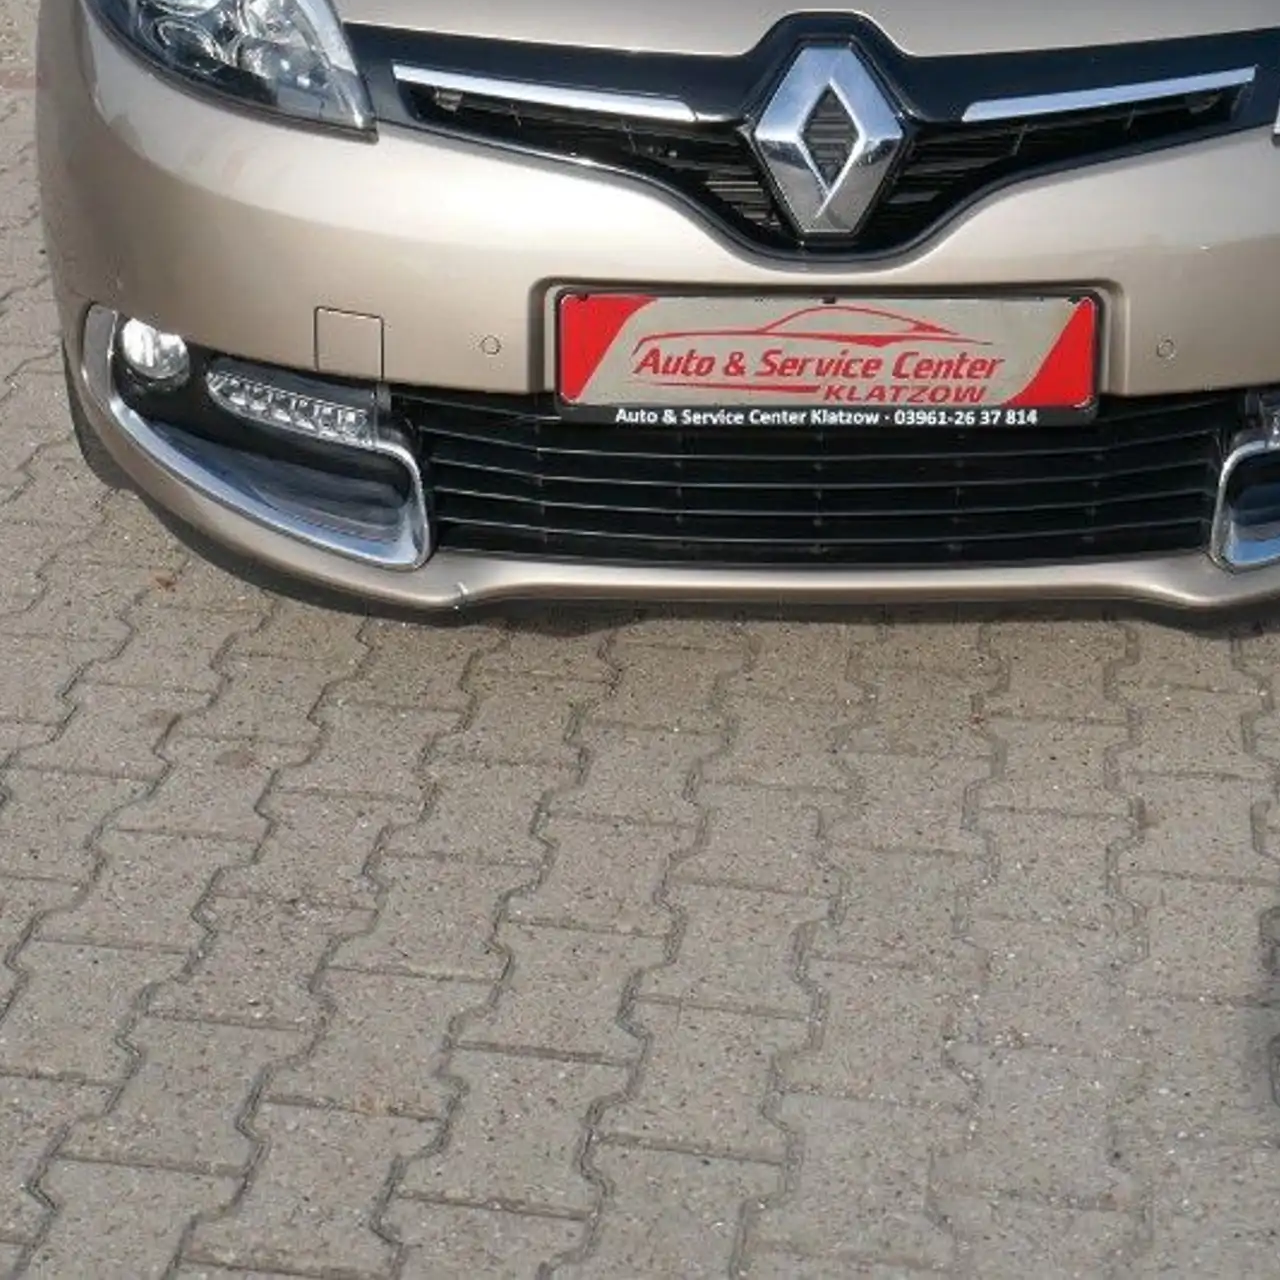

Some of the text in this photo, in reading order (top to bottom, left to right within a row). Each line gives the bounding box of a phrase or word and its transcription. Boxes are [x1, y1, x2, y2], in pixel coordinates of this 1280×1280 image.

[633, 348, 1005, 380] Auto & Service Center
[824, 385, 987, 403] KLATZOW
[616, 408, 658, 424] Auto
[662, 409, 677, 424] &
[682, 408, 745, 425] Service
[749, 409, 807, 425] Center
[811, 409, 879, 425] Klatzow
[894, 409, 975, 426] 03961-26
[980, 409, 1001, 426] 37
[1006, 409, 1038, 426] 814
